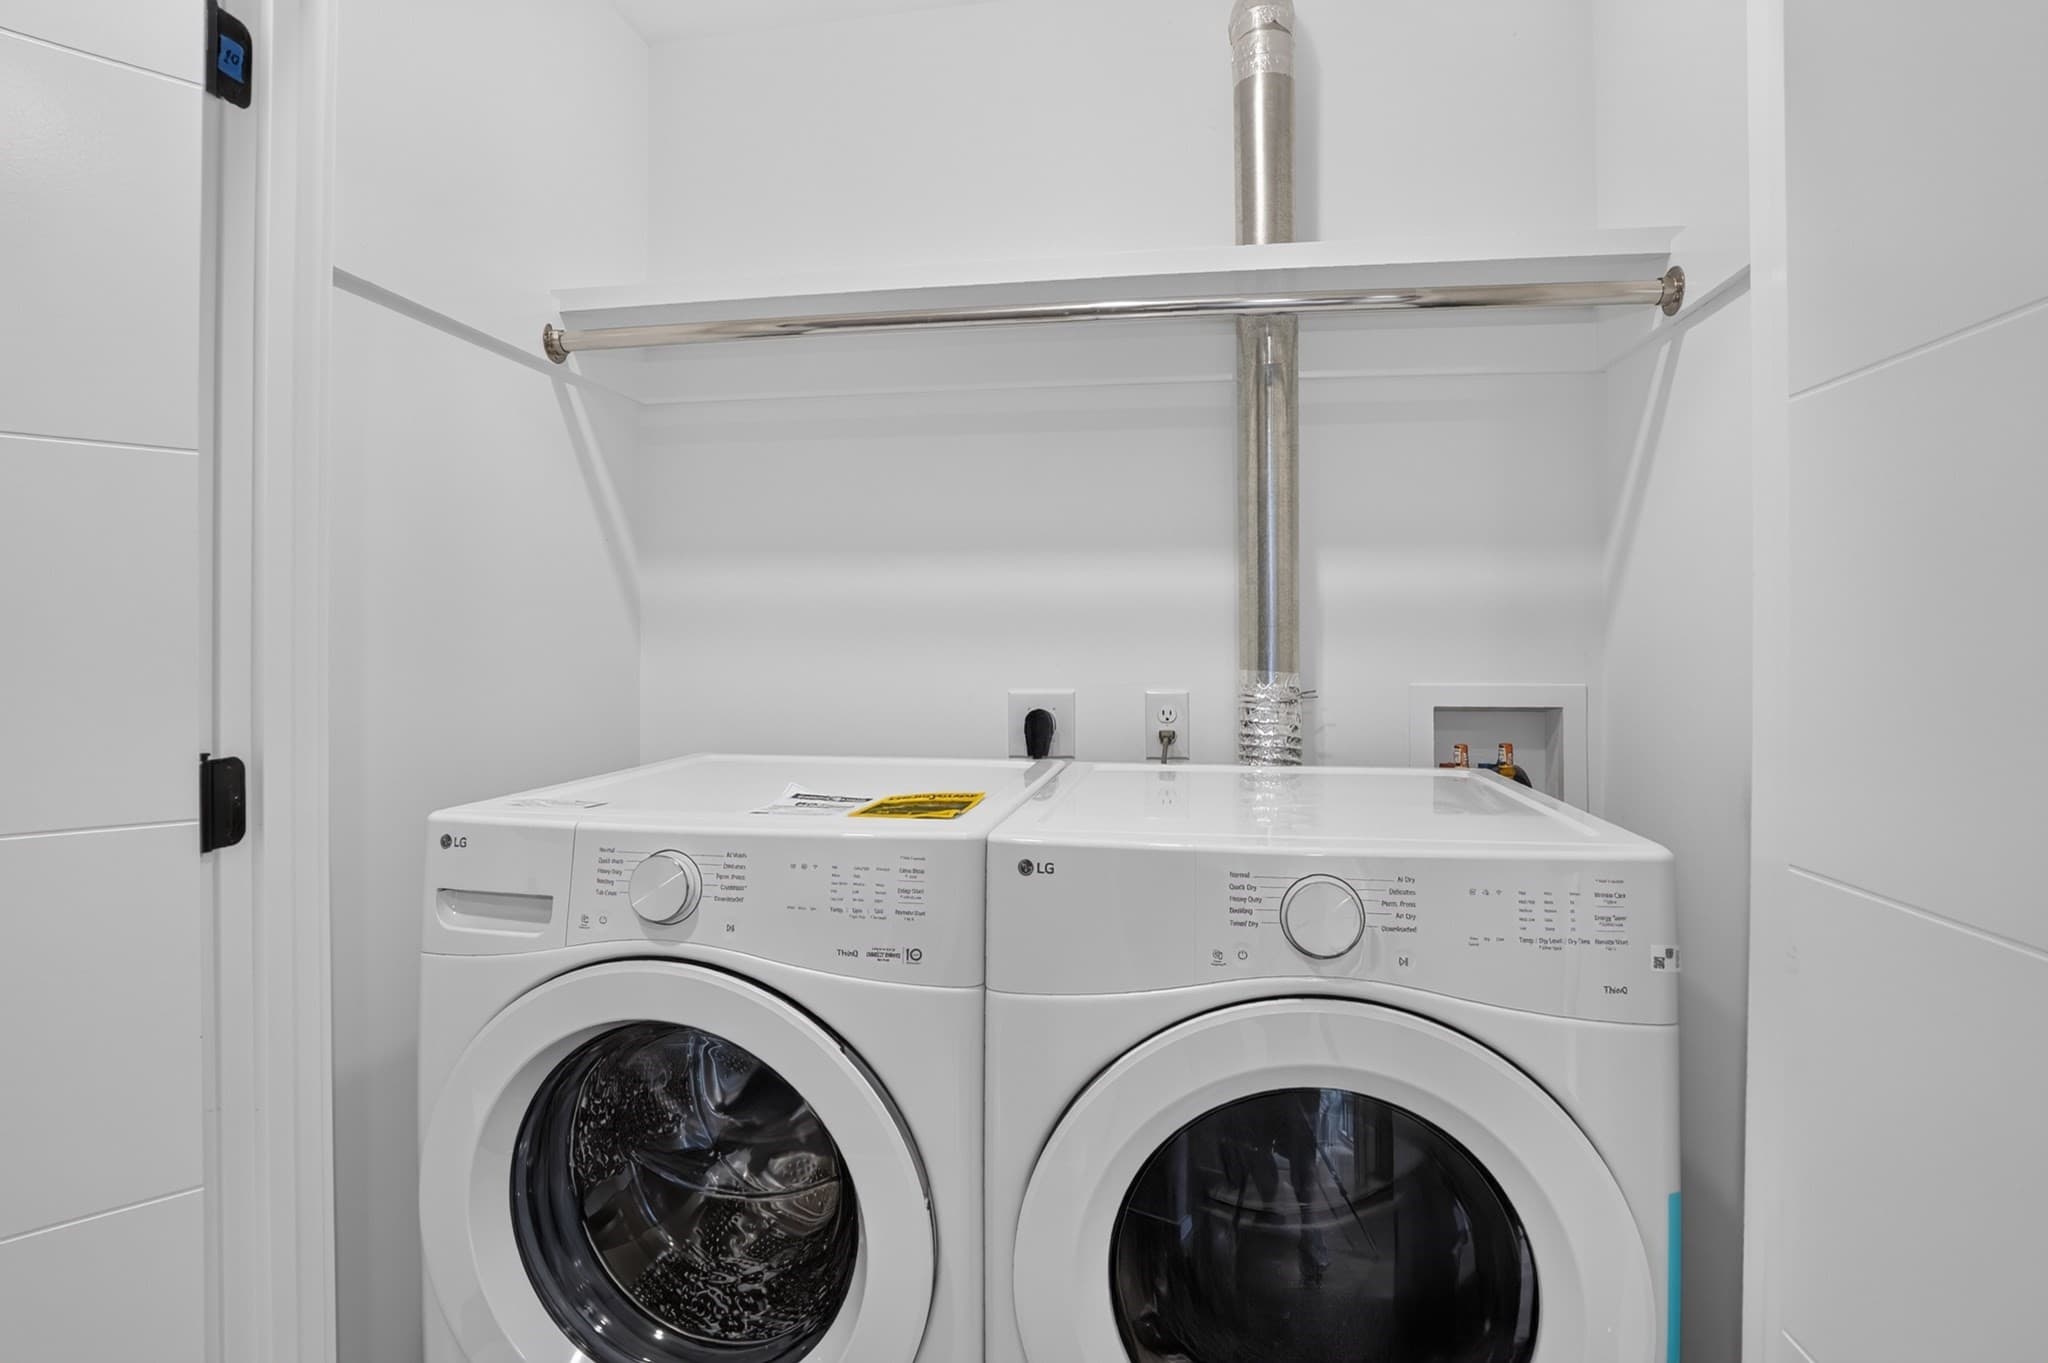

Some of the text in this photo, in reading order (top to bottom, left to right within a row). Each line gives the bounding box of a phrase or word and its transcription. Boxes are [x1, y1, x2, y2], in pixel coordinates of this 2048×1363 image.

[454, 836, 467, 848] LG
[1037, 862, 1055, 875] LG
[1229, 871, 1250, 879] Normal
[1228, 882, 1257, 892] Quick Dry
[1229, 895, 1262, 904] Heavy Duty
[1229, 906, 1253, 916] Bedding
[1247, 920, 1259, 929] Dry
[1603, 985, 1628, 995] ThinQ
